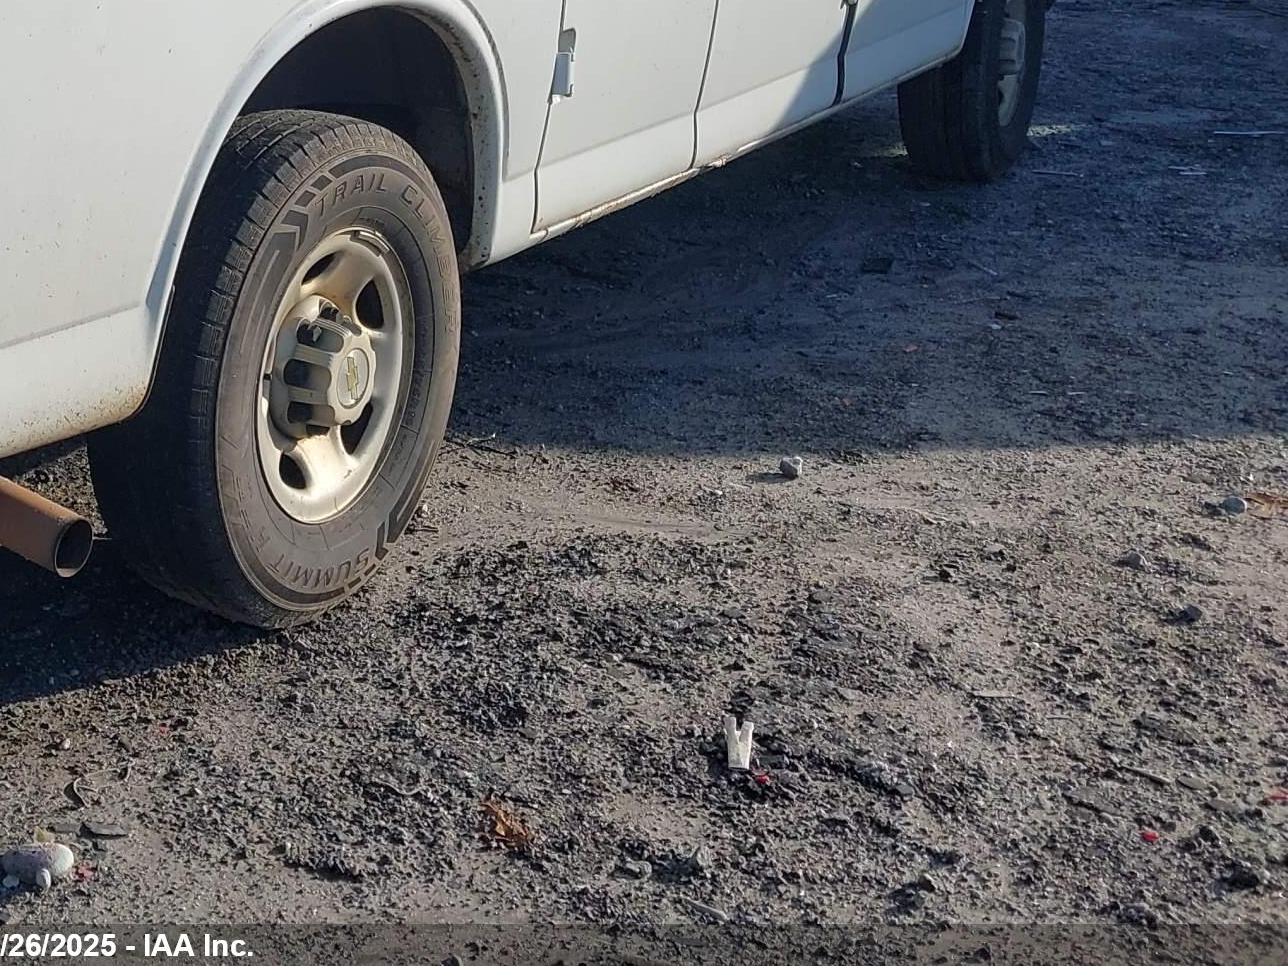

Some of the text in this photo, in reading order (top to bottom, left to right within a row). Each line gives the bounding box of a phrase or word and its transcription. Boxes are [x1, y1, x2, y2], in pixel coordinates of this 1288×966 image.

[314, 172, 457, 333] TRAIL CLIMBER
[267, 547, 370, 587] SUMMIT
